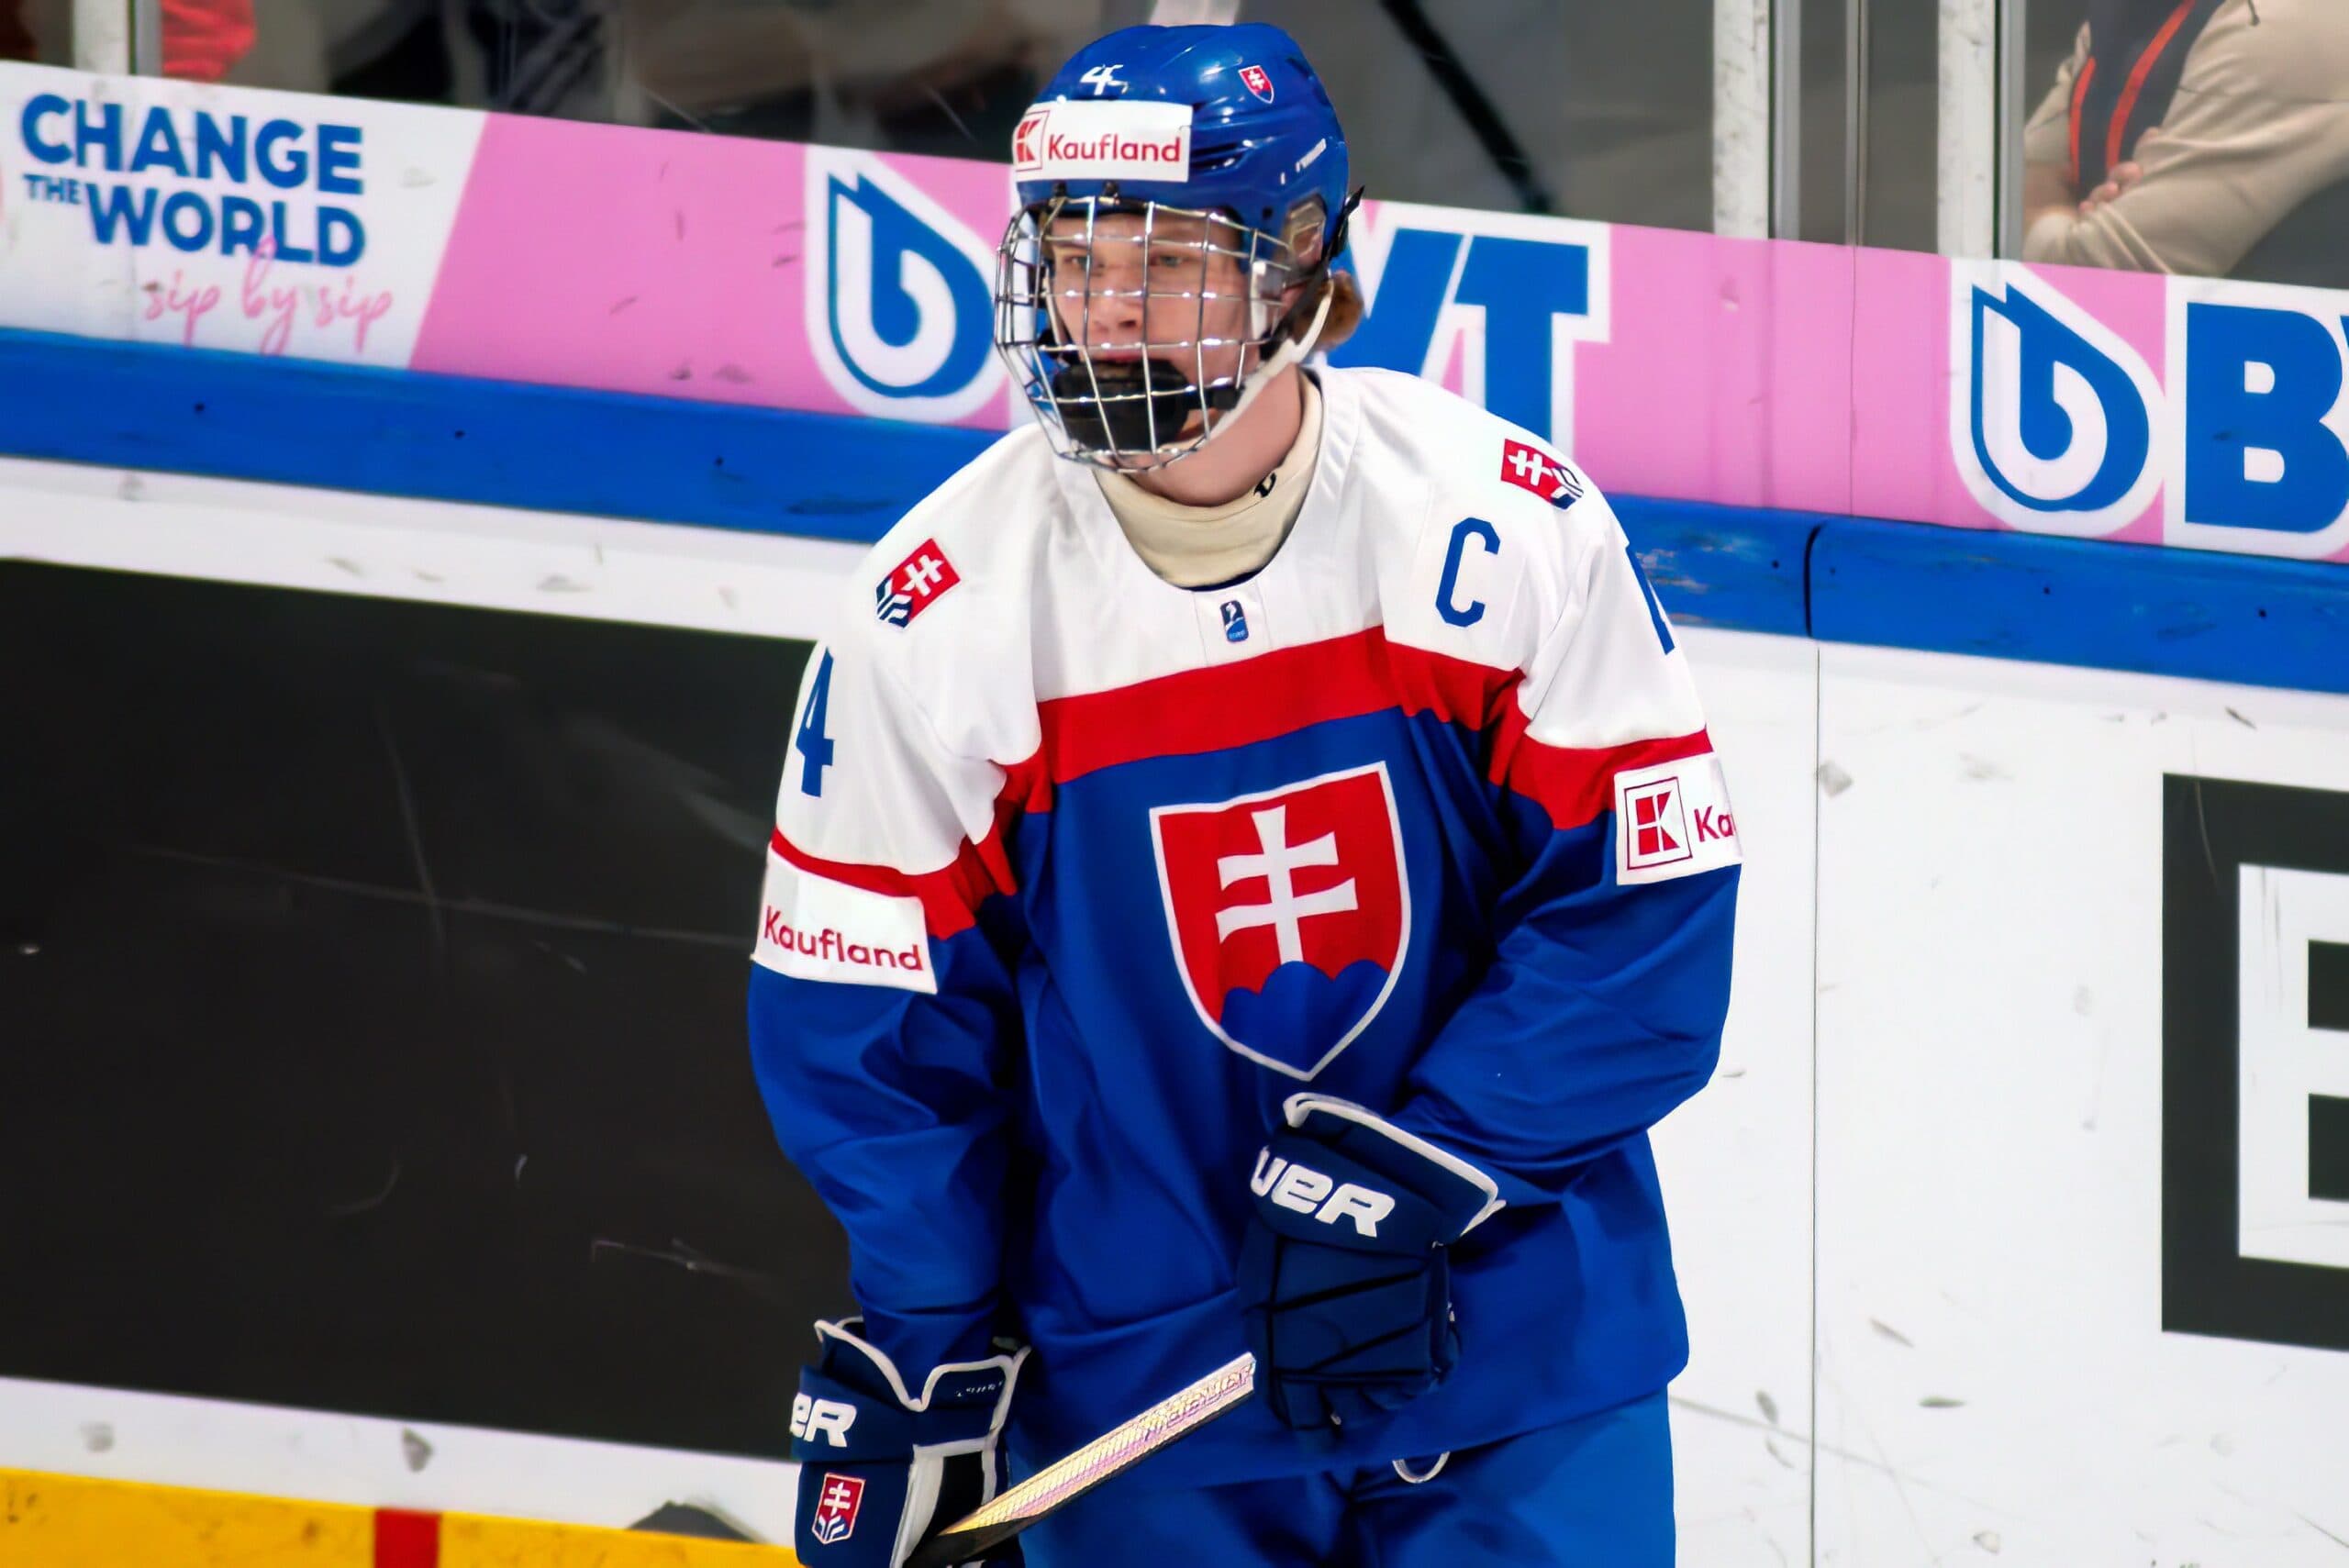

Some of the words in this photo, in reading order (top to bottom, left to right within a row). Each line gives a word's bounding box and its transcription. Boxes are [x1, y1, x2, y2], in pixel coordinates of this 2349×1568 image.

[20, 93, 364, 195] CHANGE
[1047, 133, 1181, 163] Kaufland
[22, 172, 83, 205] THE
[85, 183, 366, 267] WORLD
[144, 269, 222, 348] sip
[240, 236, 299, 357] by
[314, 275, 394, 353] sip
[1435, 517, 1501, 628] C
[796, 646, 835, 798] 4
[763, 905, 925, 972] Kaufland
